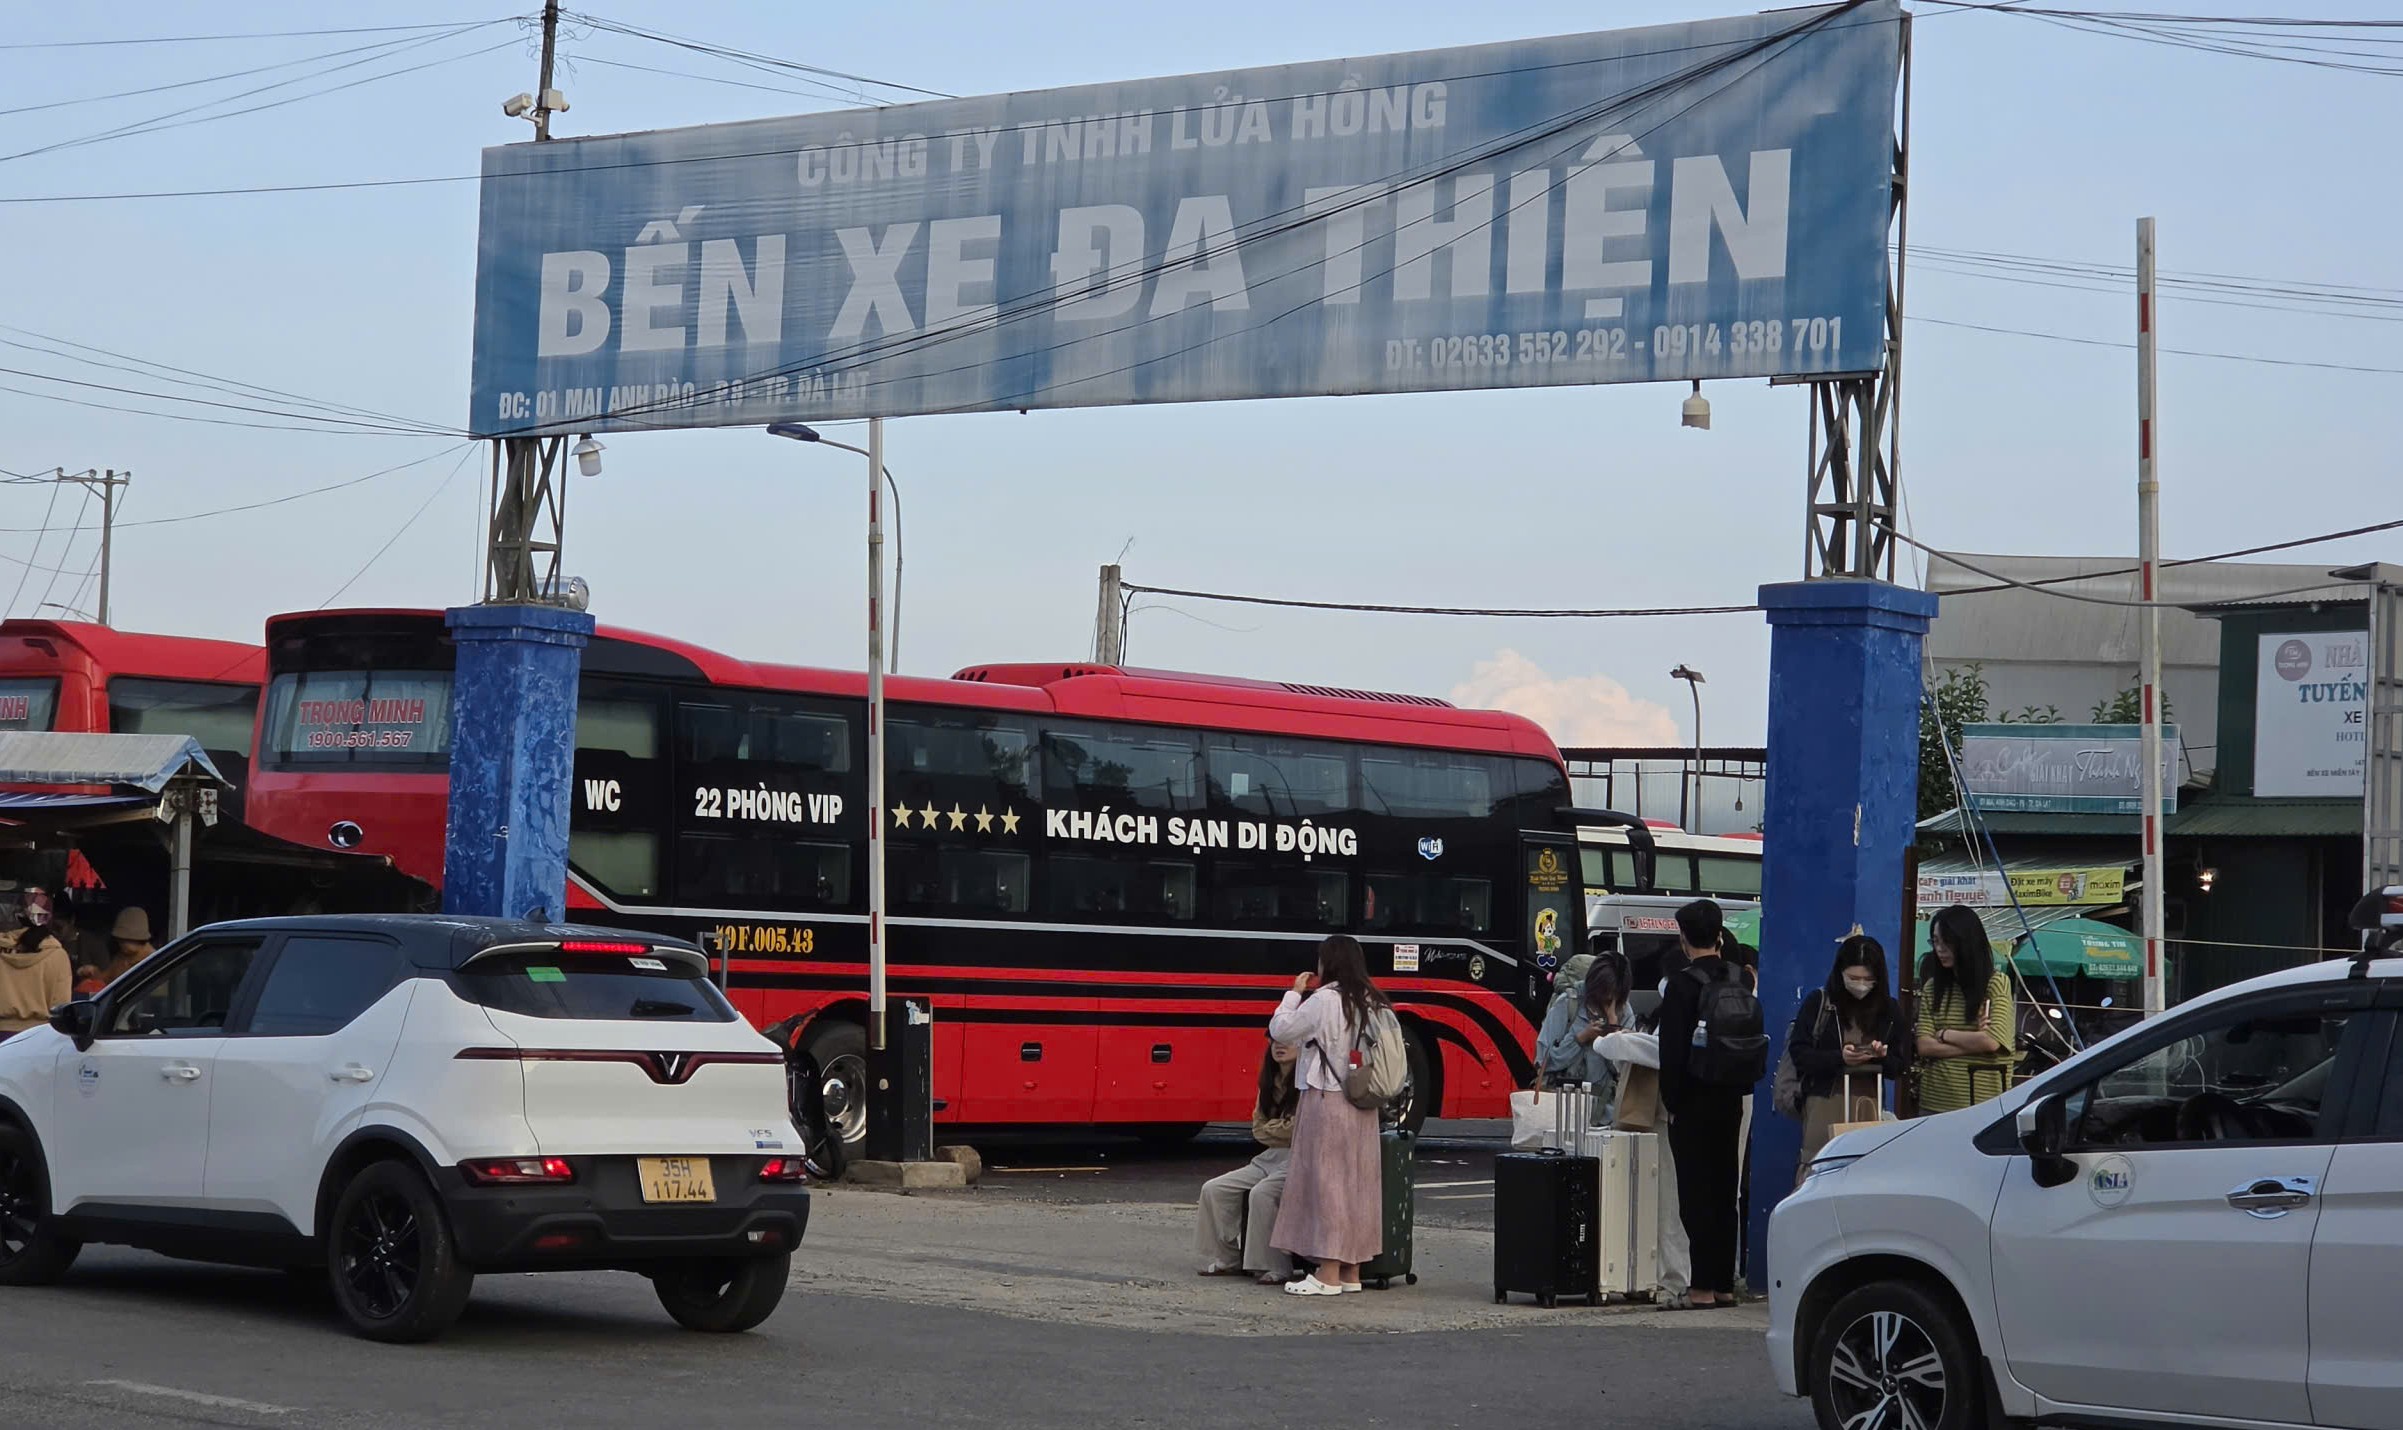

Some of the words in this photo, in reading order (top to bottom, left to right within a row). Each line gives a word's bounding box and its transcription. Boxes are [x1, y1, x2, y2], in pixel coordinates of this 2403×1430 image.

[797, 128, 927, 188] CÔNG
[946, 127, 1000, 174] TY
[1018, 106, 1156, 167] TNHH
[1171, 85, 1272, 150] LỬA
[1290, 71, 1448, 140] HỒNG
[538, 205, 787, 358] BẾN
[827, 214, 1002, 340] XE
[1050, 194, 1250, 322] ĐA
[1304, 133, 1792, 319] THIỆN
[1384, 338, 1423, 371] ĐT:
[1430, 333, 1510, 369] 02633
[1518, 330, 1568, 364] 552
[1575, 328, 1626, 362] 292
[1634, 341, 1646, 349] -
[1653, 322, 1721, 358] 0914
[1729, 319, 1783, 354] 338
[1792, 316, 1842, 352] 701
[499, 391, 531, 420] ĐC:
[536, 389, 556, 418] 01
[564, 386, 602, 418] MAI
[606, 383, 649, 414] ANH
[654, 376, 695, 410] ĐÀO
[798, 368, 826, 402] ĐÀ
[2324, 638, 2365, 669] NHÀ
[2299, 673, 2367, 703] TUYẾN
[299, 699, 365, 731] TRỌNG
[368, 698, 425, 724] MINH
[2344, 711, 2363, 724] XE
[308, 730, 413, 748] 1900.561.567
[584, 779, 621, 812] WC
[695, 787, 722, 818] 22
[727, 782, 802, 823] PHÒNG
[808, 793, 843, 824] VIP
[1046, 806, 1158, 844] KHÁCH
[1167, 816, 1228, 854] SẠN
[1238, 822, 1267, 850] DI
[1275, 818, 1357, 861] ĐỘNG
[2036, 876, 2053, 887] máy
[2090, 880, 2121, 889] maxim
[713, 923, 814, 953] 49F.005.43
[660, 1159, 692, 1177] 35H
[653, 1180, 707, 1199] 117.44
